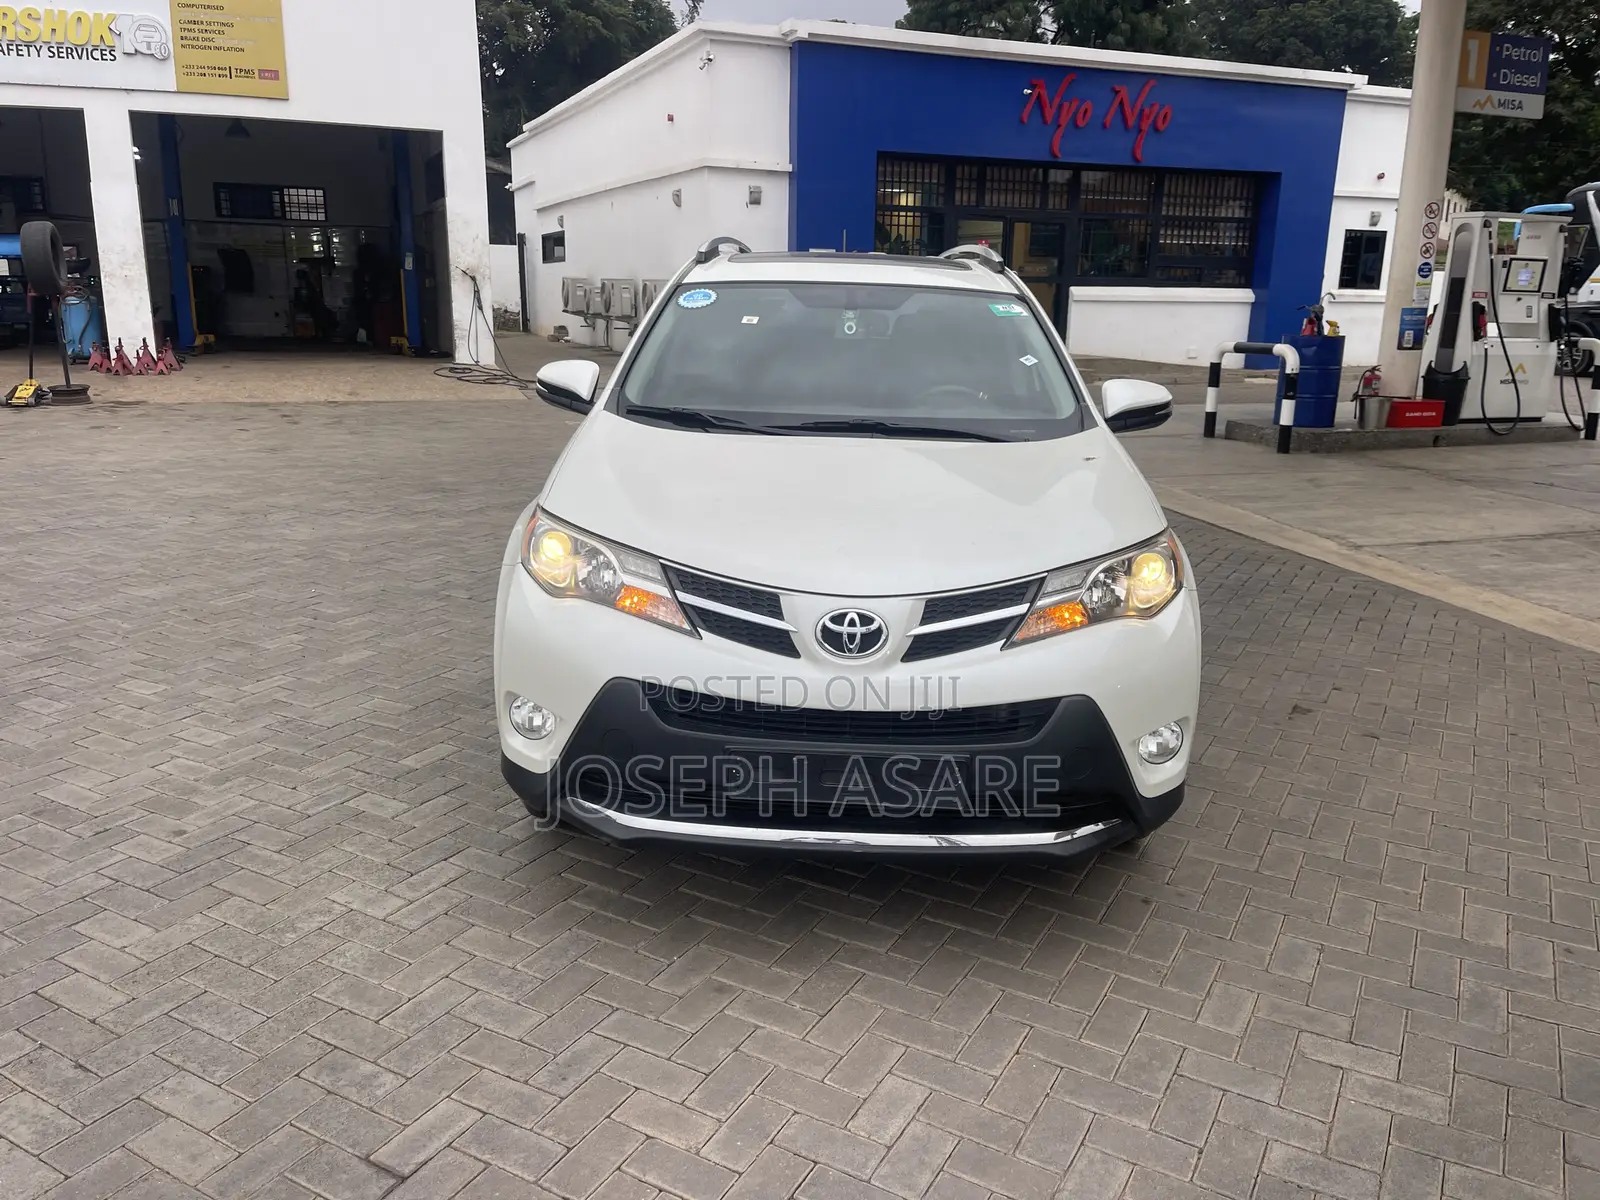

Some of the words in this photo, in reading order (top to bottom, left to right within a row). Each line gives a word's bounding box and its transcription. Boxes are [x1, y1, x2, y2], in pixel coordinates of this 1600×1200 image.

[177, 2, 225, 11] COMPUTERISED
[205, 20, 235, 28] SETTINGS
[47, 45, 117, 62] SERVICES
[213, 44, 245, 53] INFLATION
[1502, 43, 1544, 63] Petrol
[234, 67, 256, 76] TPMS
[1499, 69, 1542, 88] Diesel
[1497, 98, 1524, 111] MISA
[1020, 73, 1093, 159] Nyo
[1103, 79, 1173, 163] Nyo
